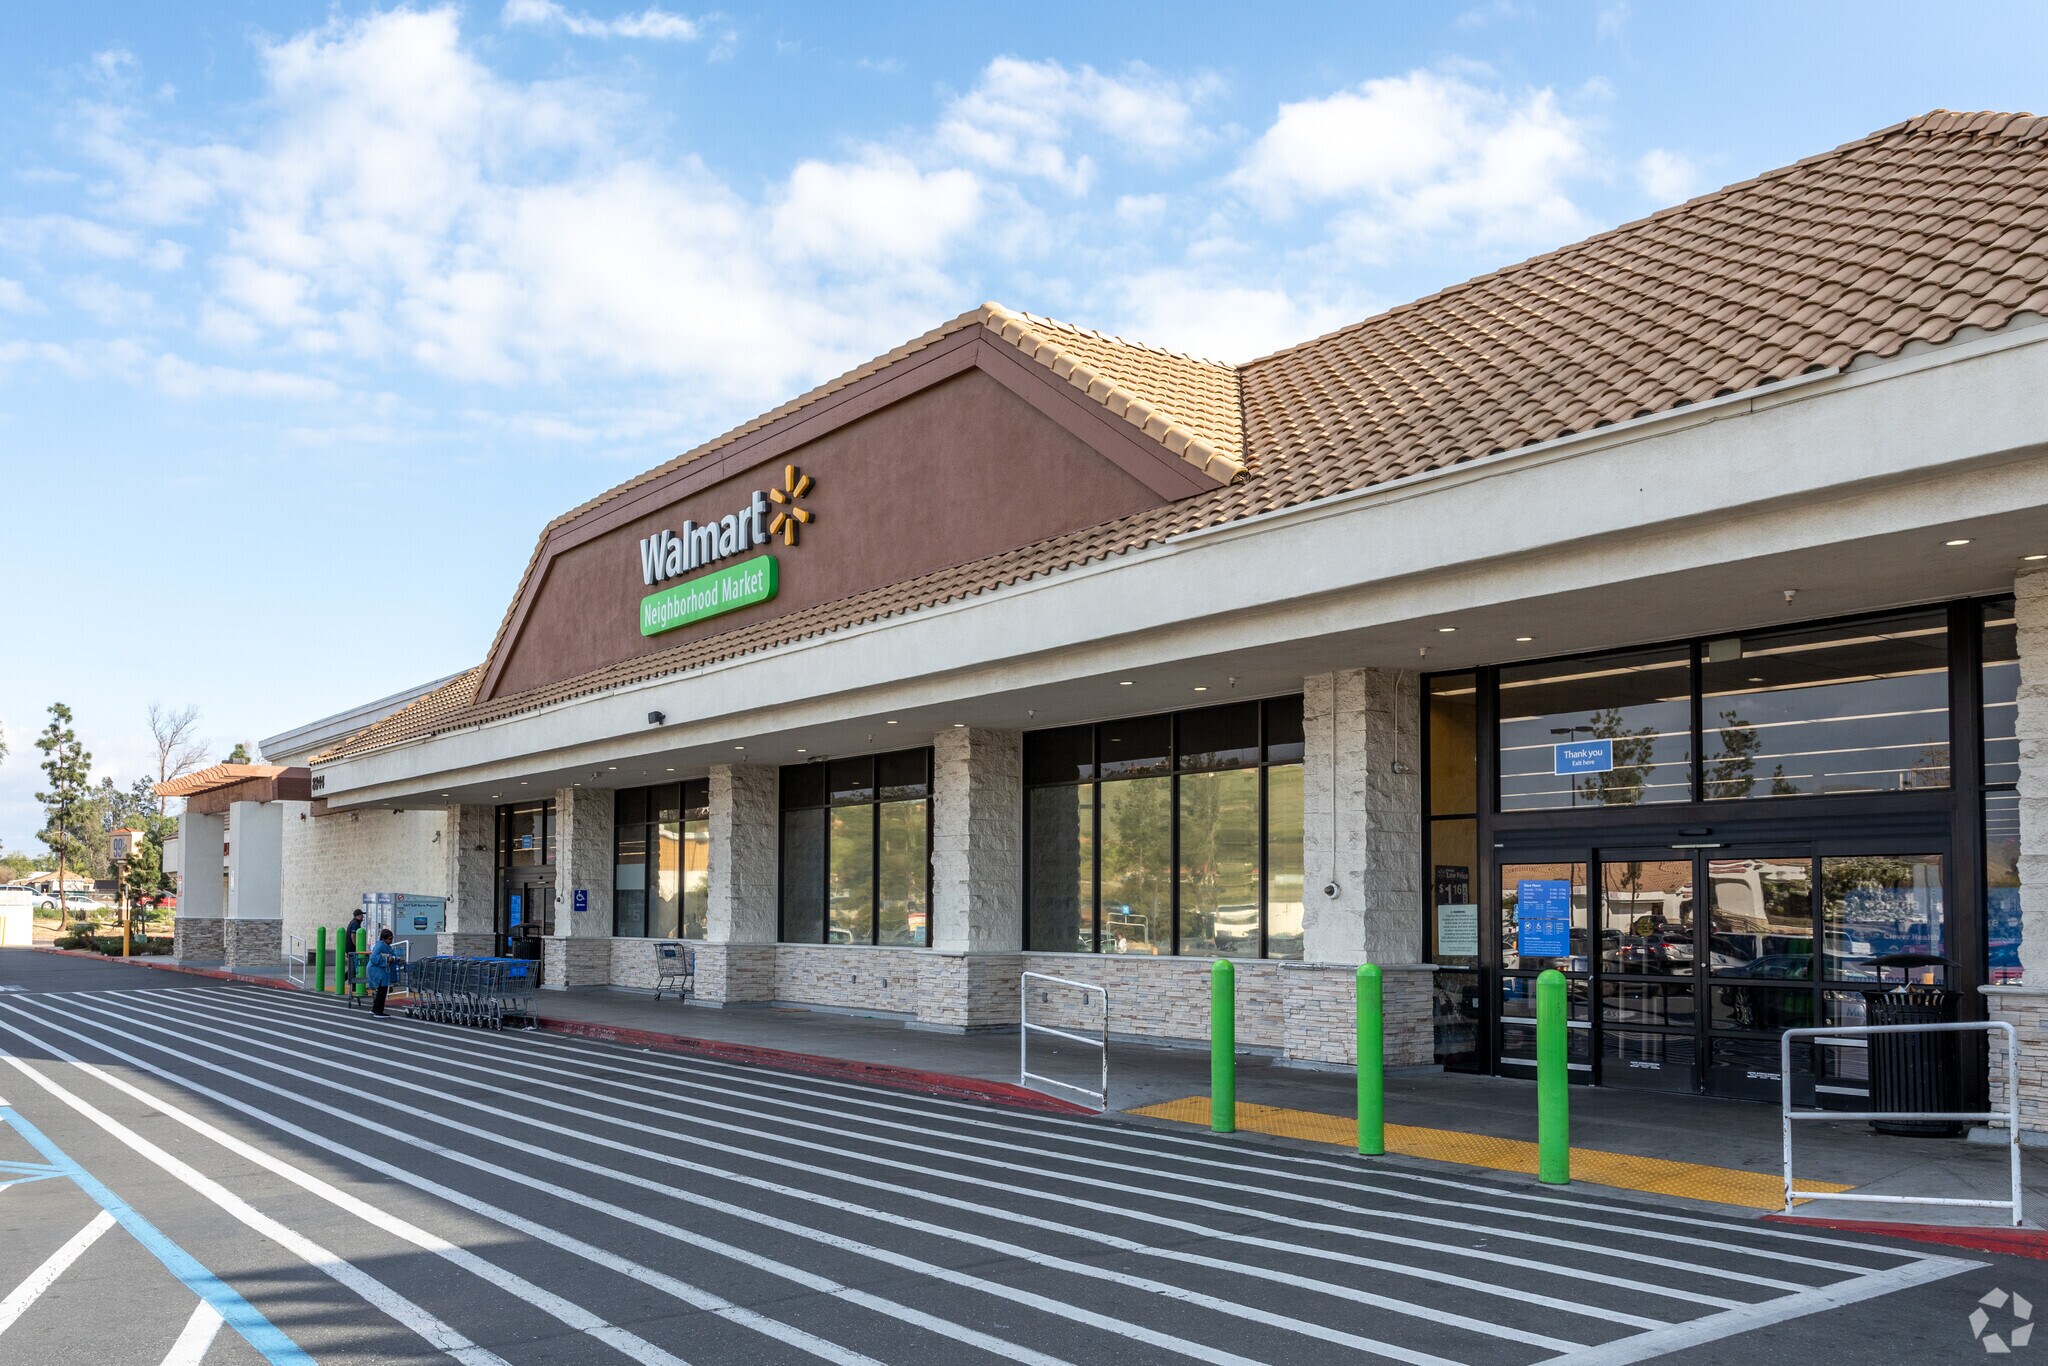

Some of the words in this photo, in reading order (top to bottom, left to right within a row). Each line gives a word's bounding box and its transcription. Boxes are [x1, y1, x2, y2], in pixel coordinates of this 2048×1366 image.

[640, 490, 768, 585] Walmart
[644, 581, 719, 628] Neighborhood
[722, 568, 764, 604] Market
[1564, 749, 1588, 759] Thank
[1588, 749, 1603, 759] you
[1883, 932, 1910, 941] Clover
[1911, 932, 1940, 941] Health
